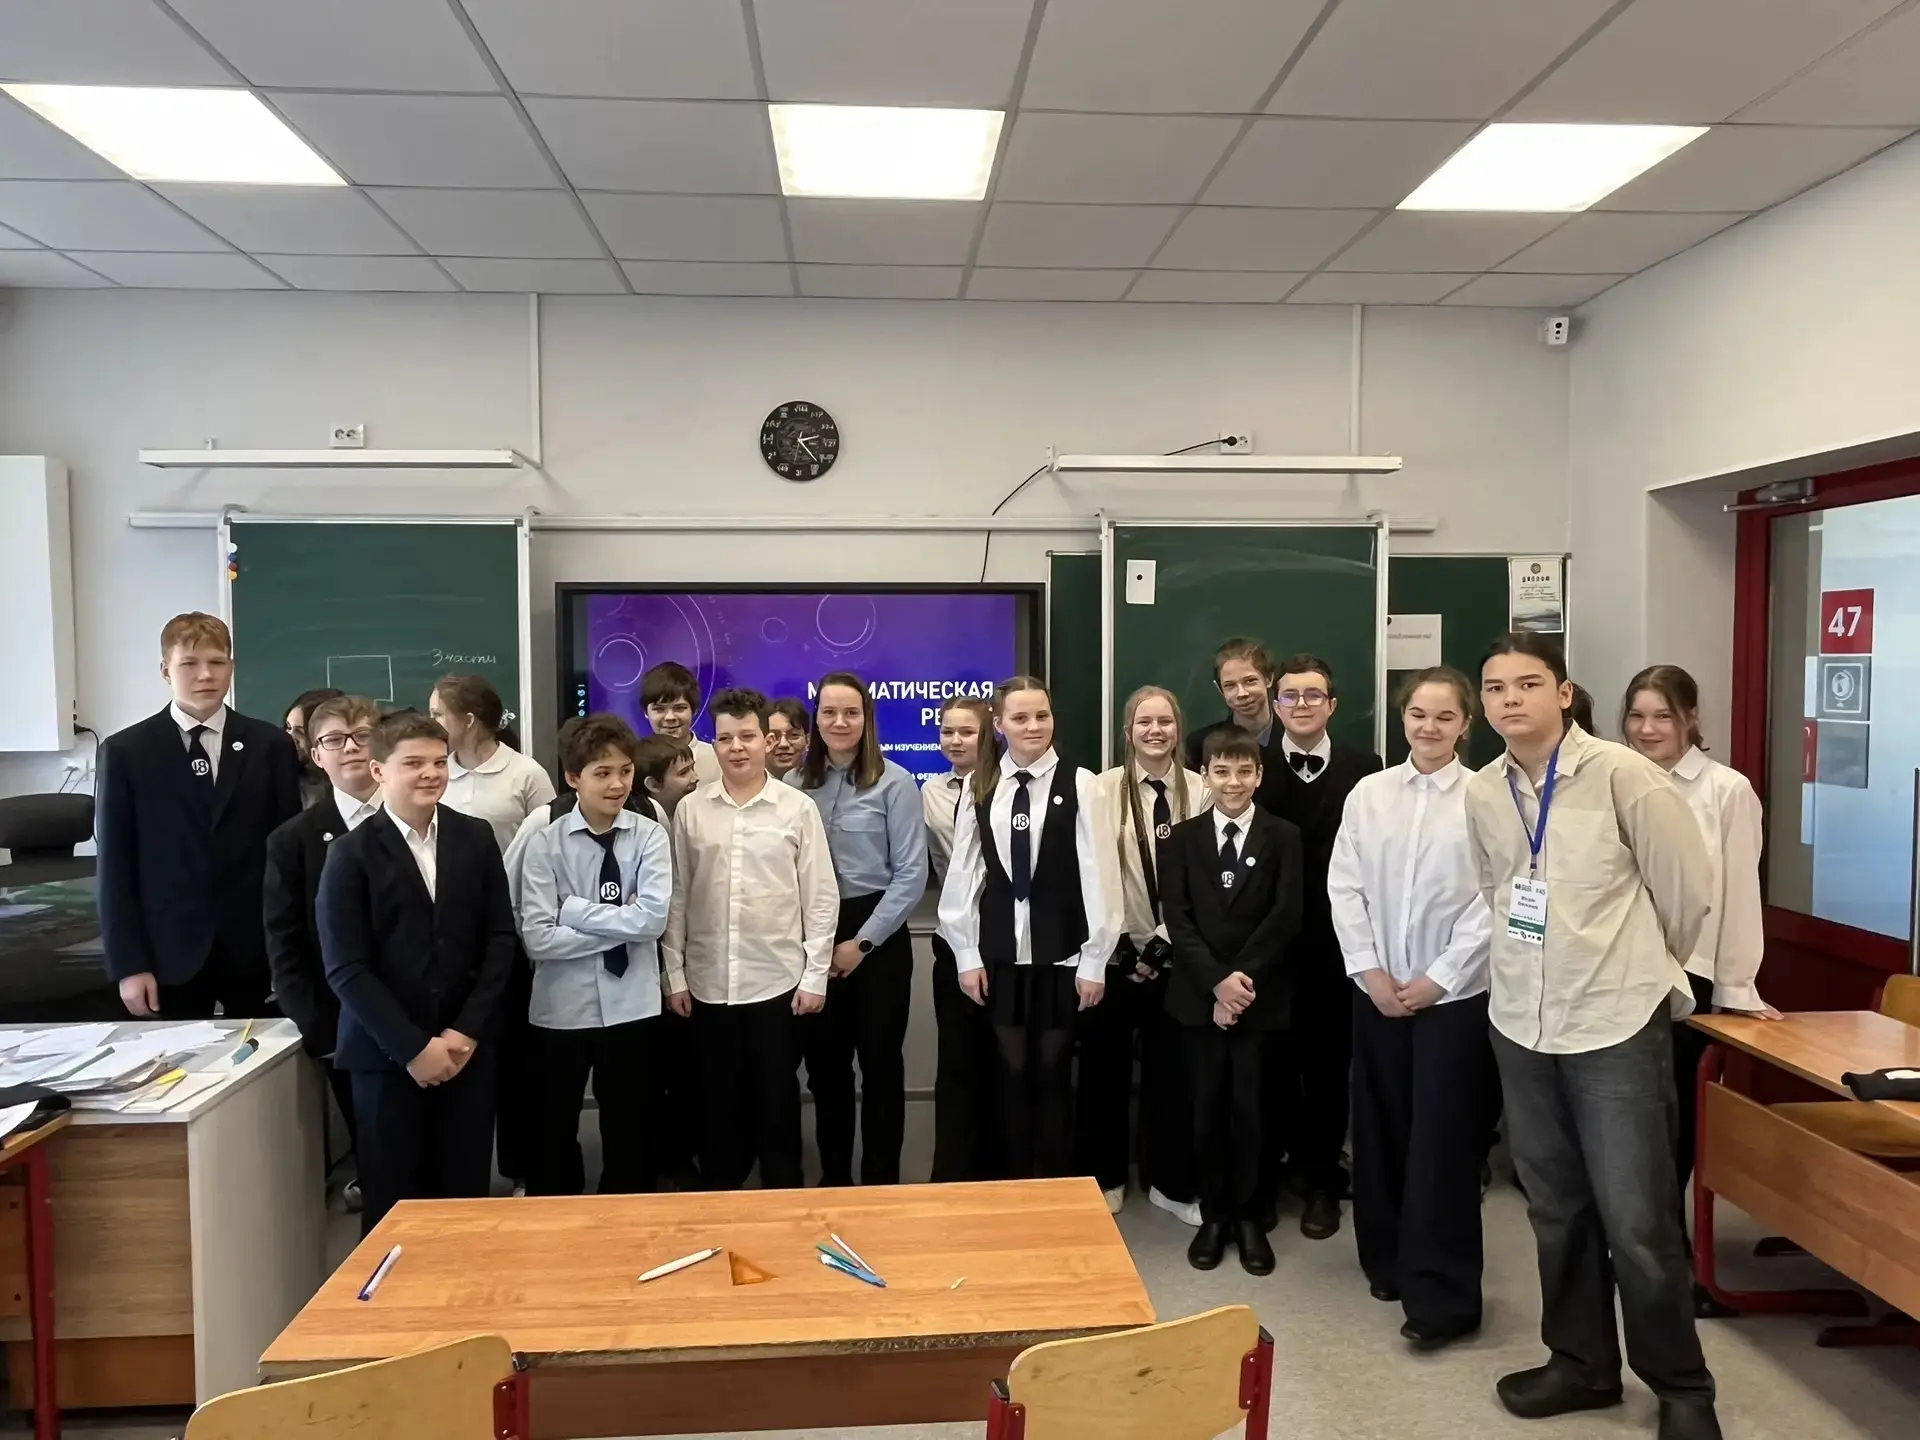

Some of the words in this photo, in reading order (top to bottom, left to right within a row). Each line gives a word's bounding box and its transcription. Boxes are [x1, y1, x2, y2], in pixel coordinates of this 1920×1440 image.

[1828, 606, 1862, 637] 47
[807, 681, 994, 700] МАТИЧЕСКАЯ
[193, 760, 208, 774] 18
[1014, 815, 1028, 828] 18
[1158, 825, 1170, 837] 18
[1222, 872, 1234, 886] 18
[604, 883, 618, 898] 18
